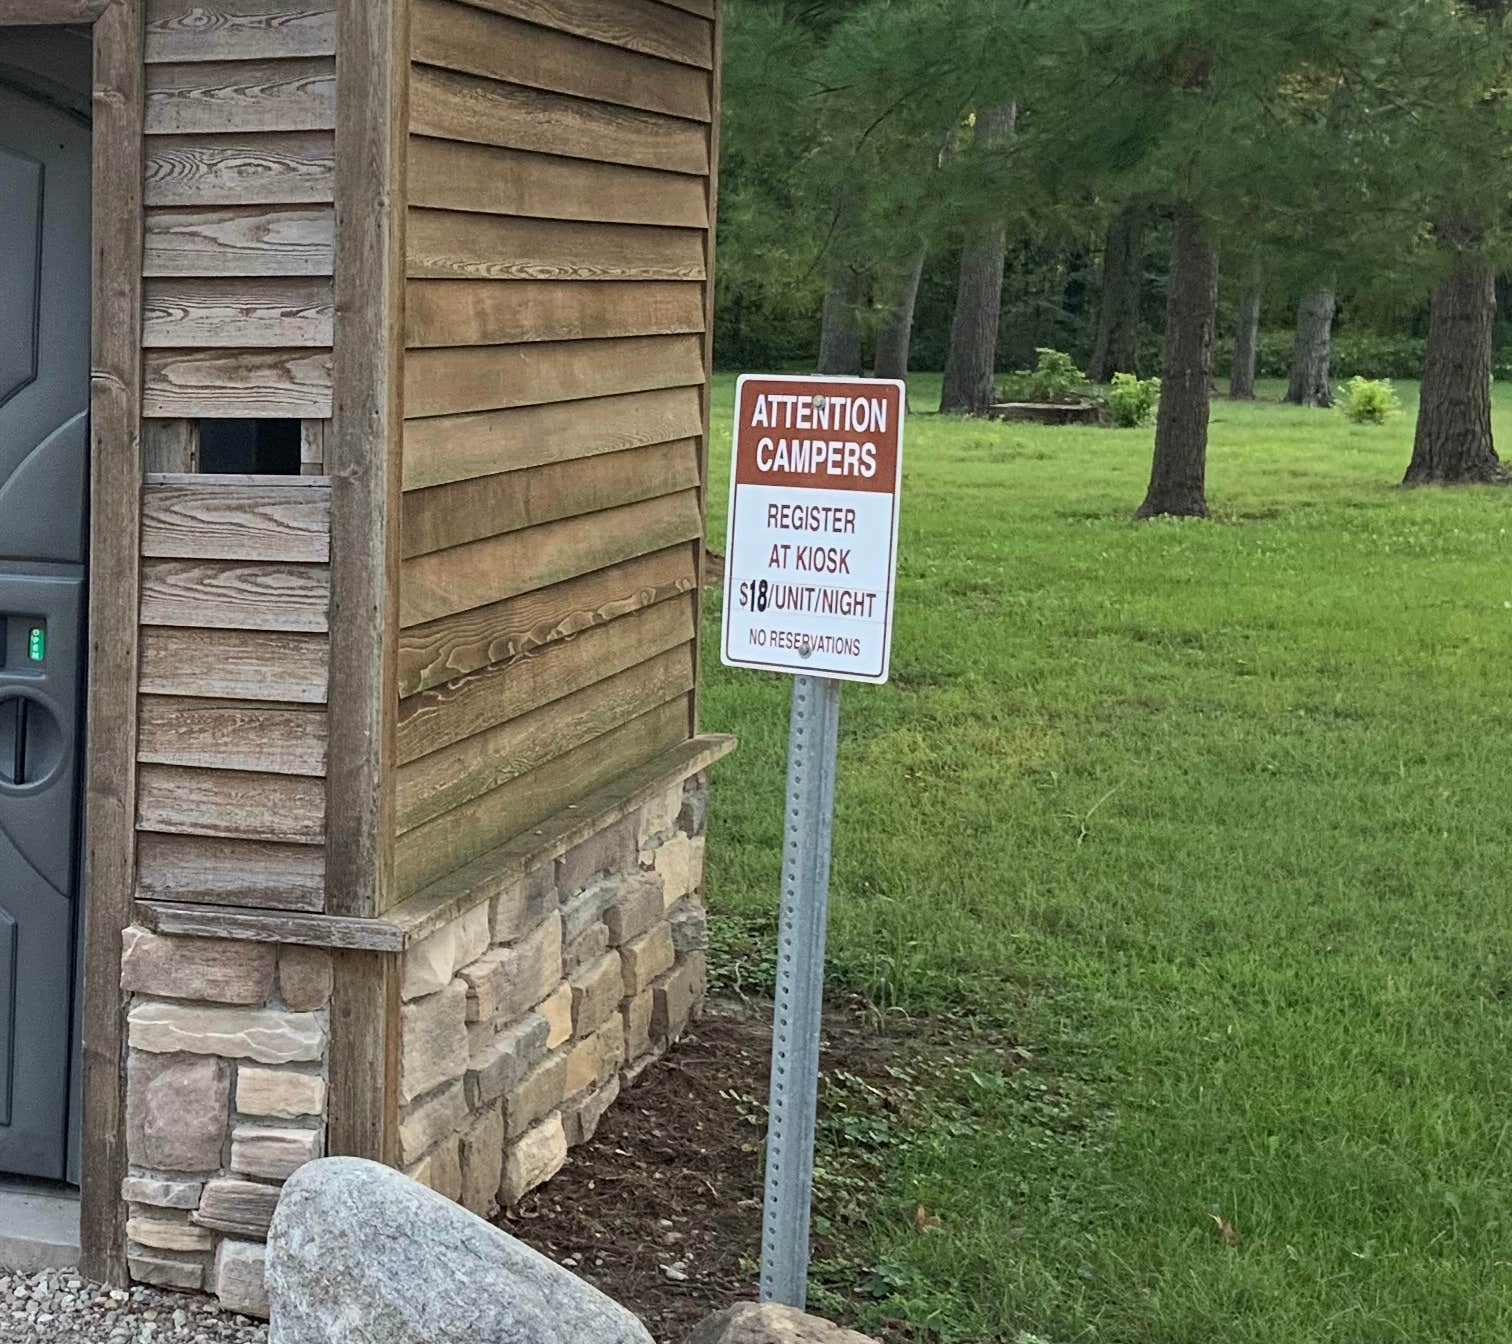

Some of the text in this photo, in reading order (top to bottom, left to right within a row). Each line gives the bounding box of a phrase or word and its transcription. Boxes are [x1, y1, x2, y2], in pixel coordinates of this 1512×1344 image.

[751, 394, 888, 433] ATTENTION
[756, 437, 877, 478] CAMPERS
[767, 503, 856, 534] REGISTER
[768, 543, 851, 574] AT KIOSK
[749, 628, 861, 657] NO RESERVATIONS
